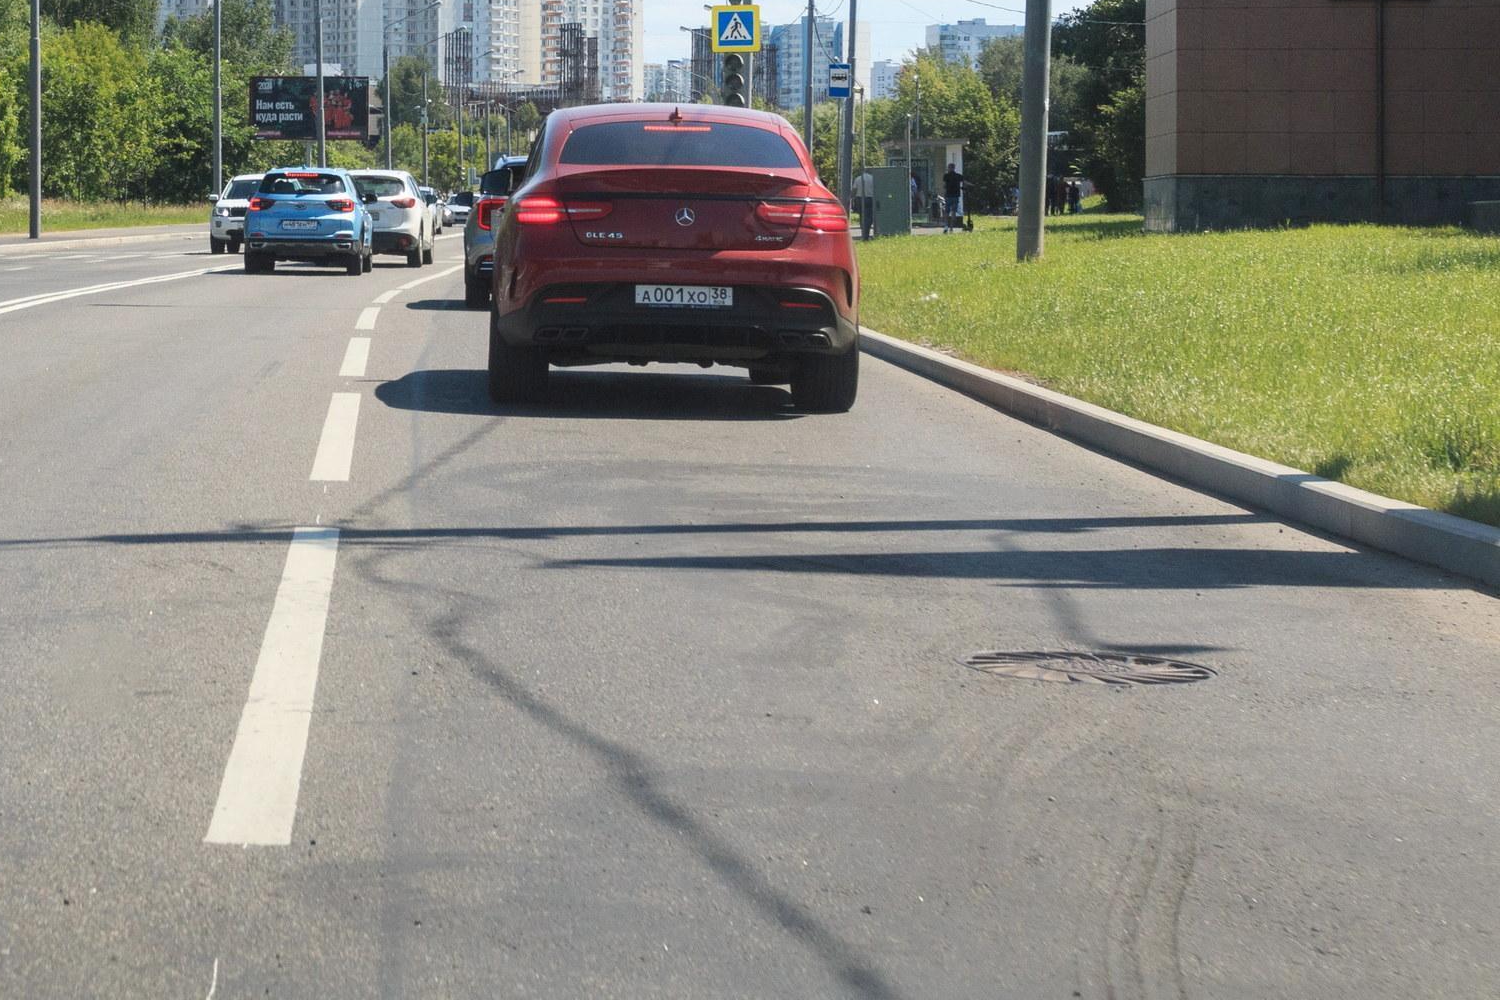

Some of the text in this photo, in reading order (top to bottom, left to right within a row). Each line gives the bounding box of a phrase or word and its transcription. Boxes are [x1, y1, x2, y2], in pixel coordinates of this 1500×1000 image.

[256, 99, 294, 110] Нам есть
[256, 112, 303, 123] куда расти
[711, 288, 727, 299] 38
